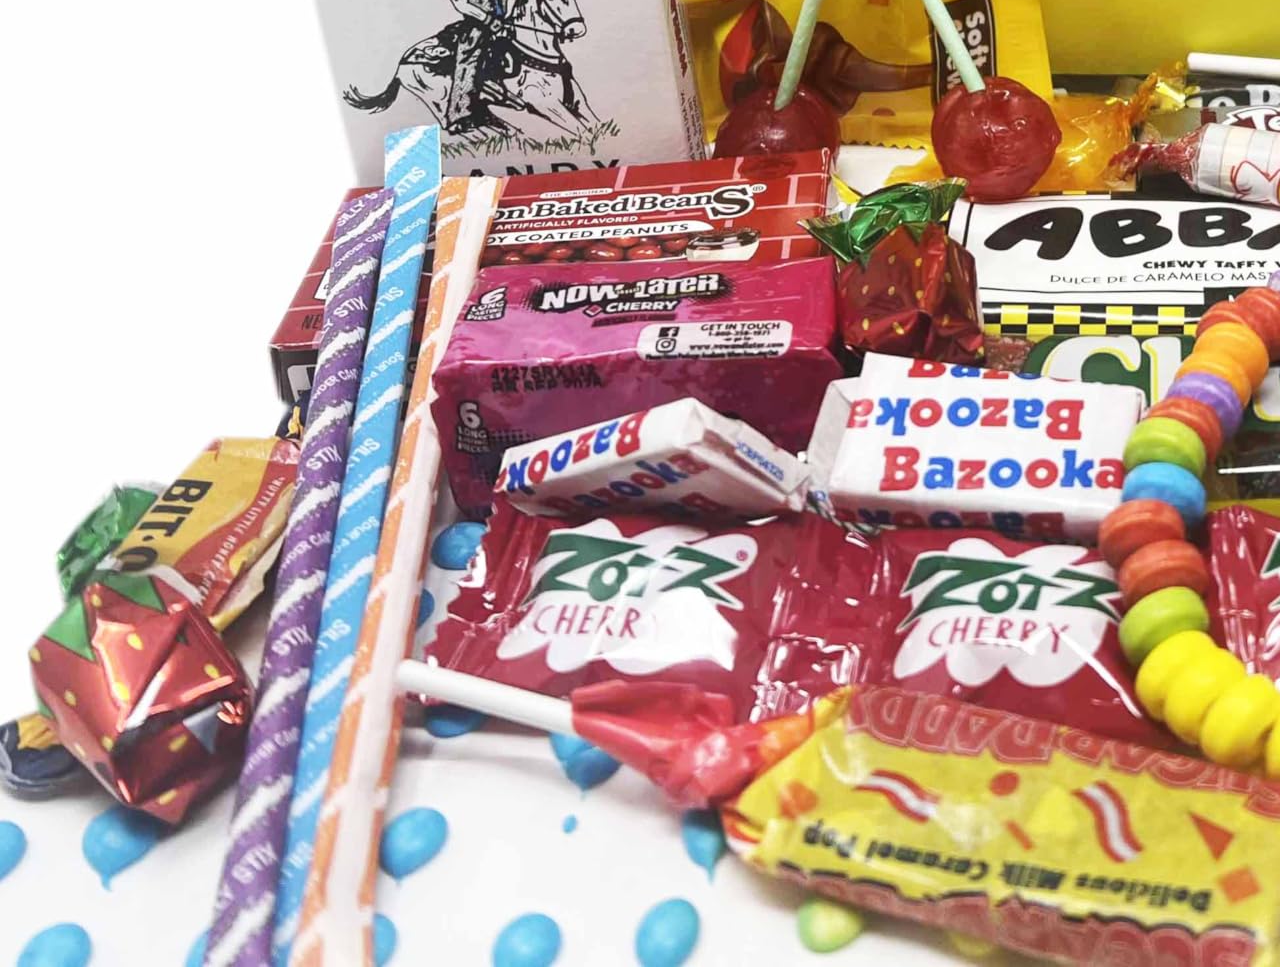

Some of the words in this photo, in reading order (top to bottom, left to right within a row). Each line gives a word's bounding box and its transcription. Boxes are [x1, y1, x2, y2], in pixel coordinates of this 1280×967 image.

[966, 10, 989, 68] Soft
[336, 199, 368, 228] SILLY
[529, 196, 630, 218] Baked
[494, 218, 576, 232] ARTIFICIALLY
[576, 215, 639, 226] FLAVORED
[514, 228, 601, 243] COATED
[600, 222, 690, 239] PEANUTS
[1049, 273, 1102, 286] DULCE
[1106, 274, 1128, 284] DE
[1132, 270, 1225, 284] CARAMELO
[1142, 259, 1206, 270] CHEWY
[1214, 259, 1268, 270] TAFFY
[333, 295, 369, 319] STIX
[471, 301, 505, 313] LONG
[480, 287, 507, 305] 6
[540, 283, 620, 312] NOW
[605, 300, 679, 314] CHERRY
[700, 323, 724, 331] GET
[724, 322, 737, 330] IN
[739, 322, 781, 331] TOUCH
[458, 401, 482, 429] 6
[845, 396, 1085, 440] Bazooka
[305, 443, 343, 472] STIX
[878, 446, 1125, 492] Bazooka
[271, 623, 313, 657] STIX
[928, 612, 1071, 654] CHERRY
[801, 820, 853, 860] Pop
[864, 835, 993, 883] Caramel
[998, 861, 1067, 892] Milk
[1073, 872, 1214, 913] Delicious
